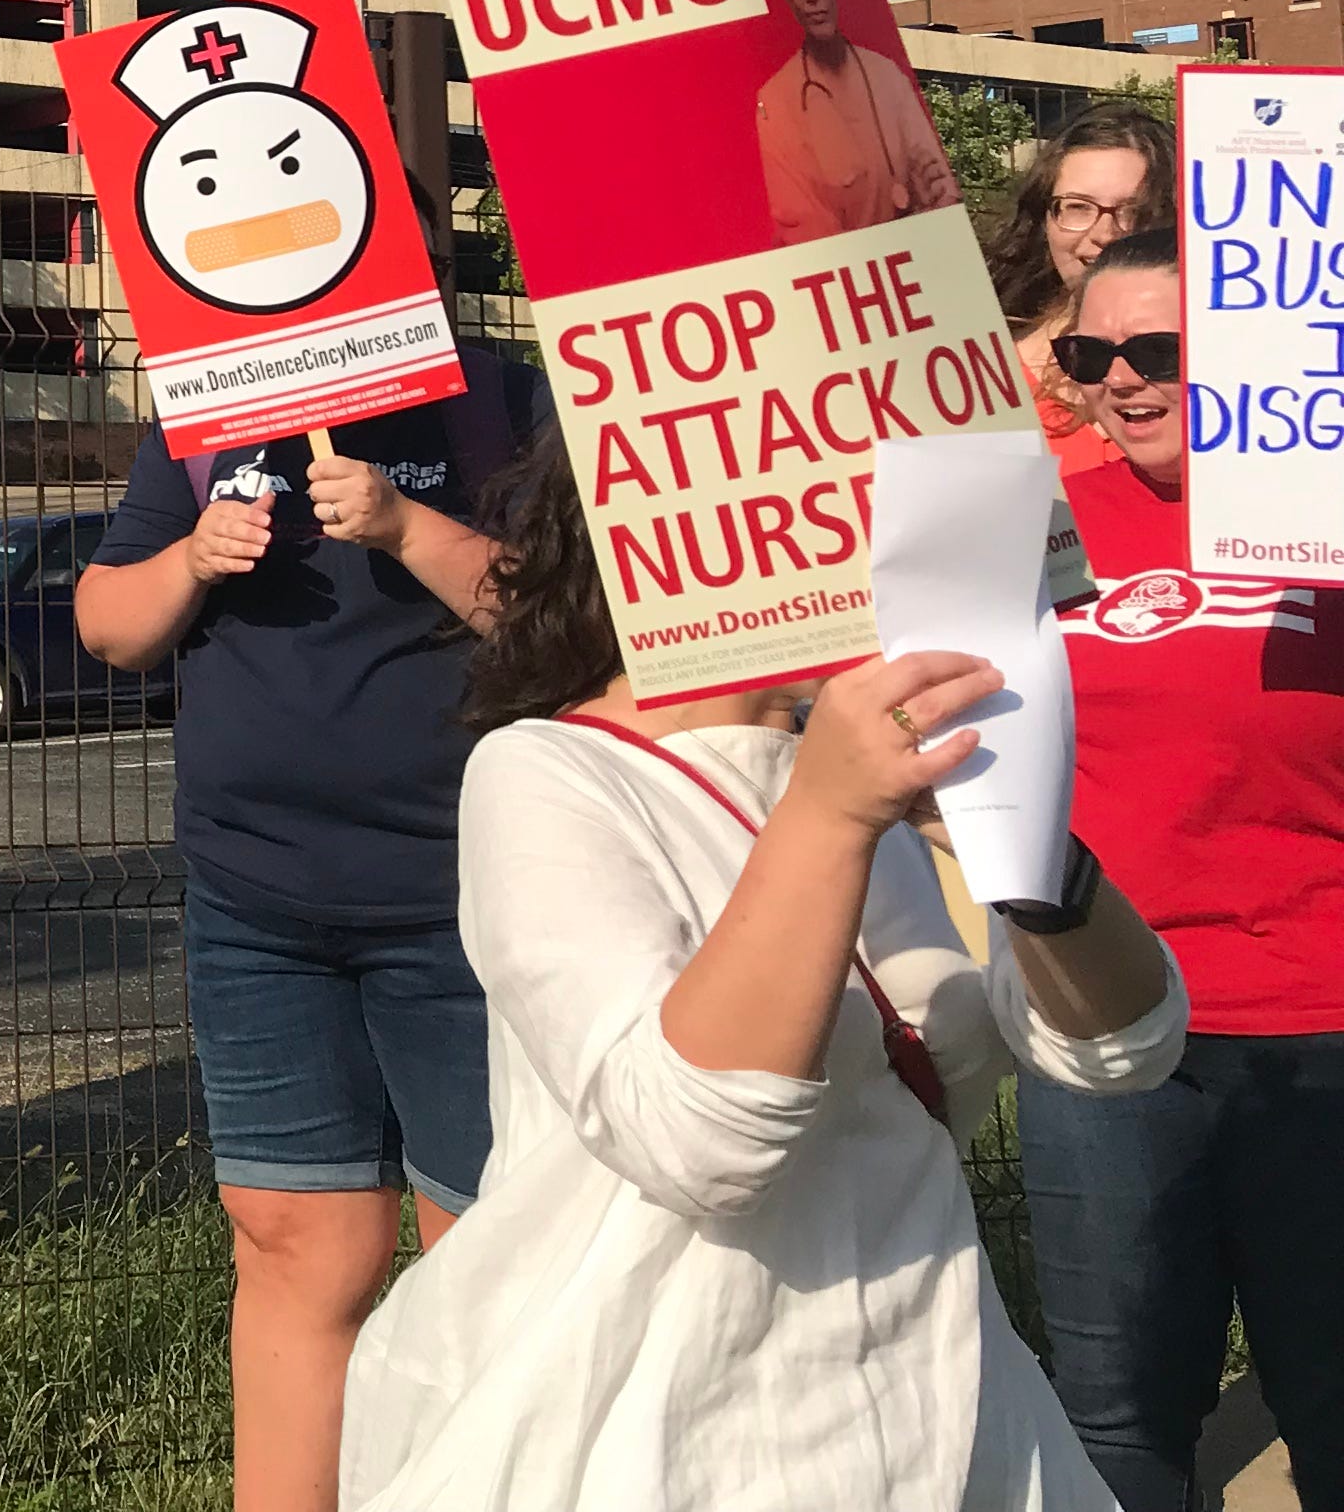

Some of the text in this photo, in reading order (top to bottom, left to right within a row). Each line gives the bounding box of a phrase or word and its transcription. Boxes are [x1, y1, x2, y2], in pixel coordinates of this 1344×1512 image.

[165, 321, 439, 400] www.DontSilenceCincyNurses.com
[557, 251, 936, 408] STOP THE
[593, 331, 1023, 508] ATTACK ON
